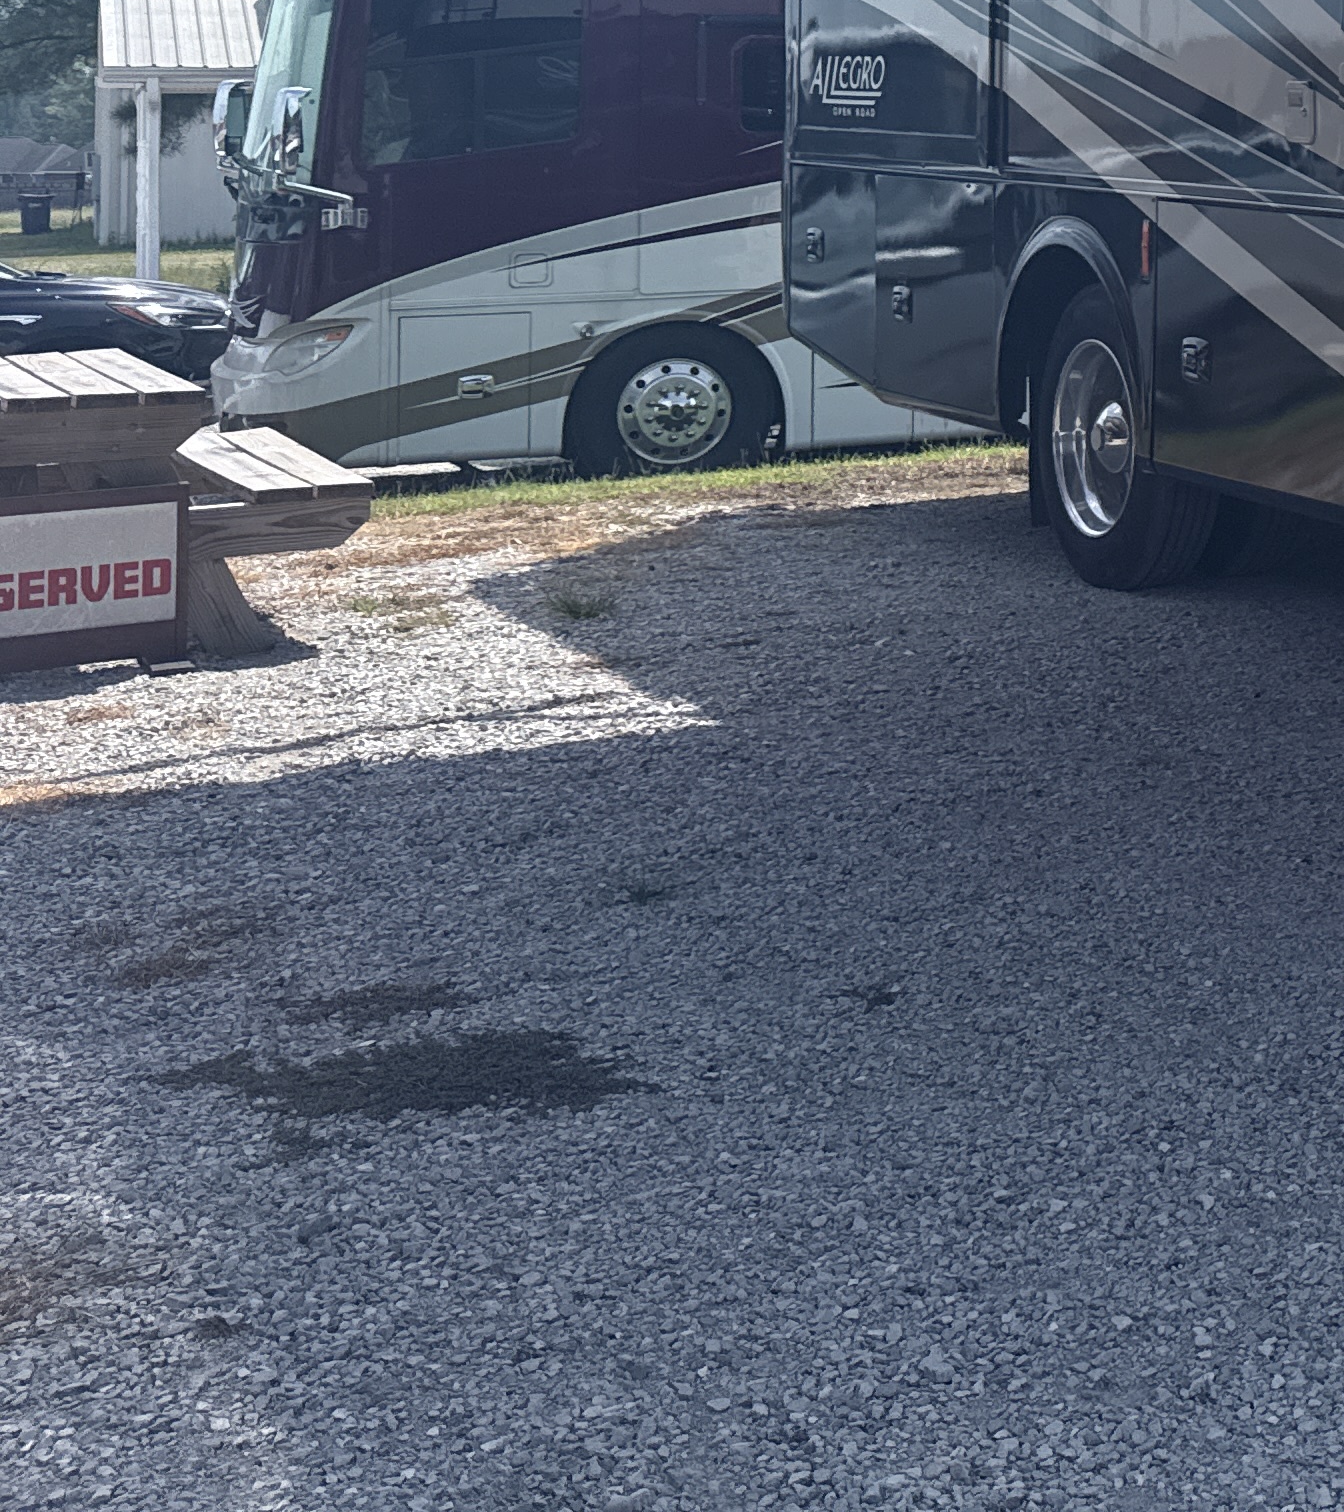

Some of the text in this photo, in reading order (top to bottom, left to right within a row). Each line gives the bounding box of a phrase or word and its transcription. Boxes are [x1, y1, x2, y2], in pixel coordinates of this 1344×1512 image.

[809, 55, 886, 106] ALLEGRO
[832, 106, 876, 118] OPEN ROAD
